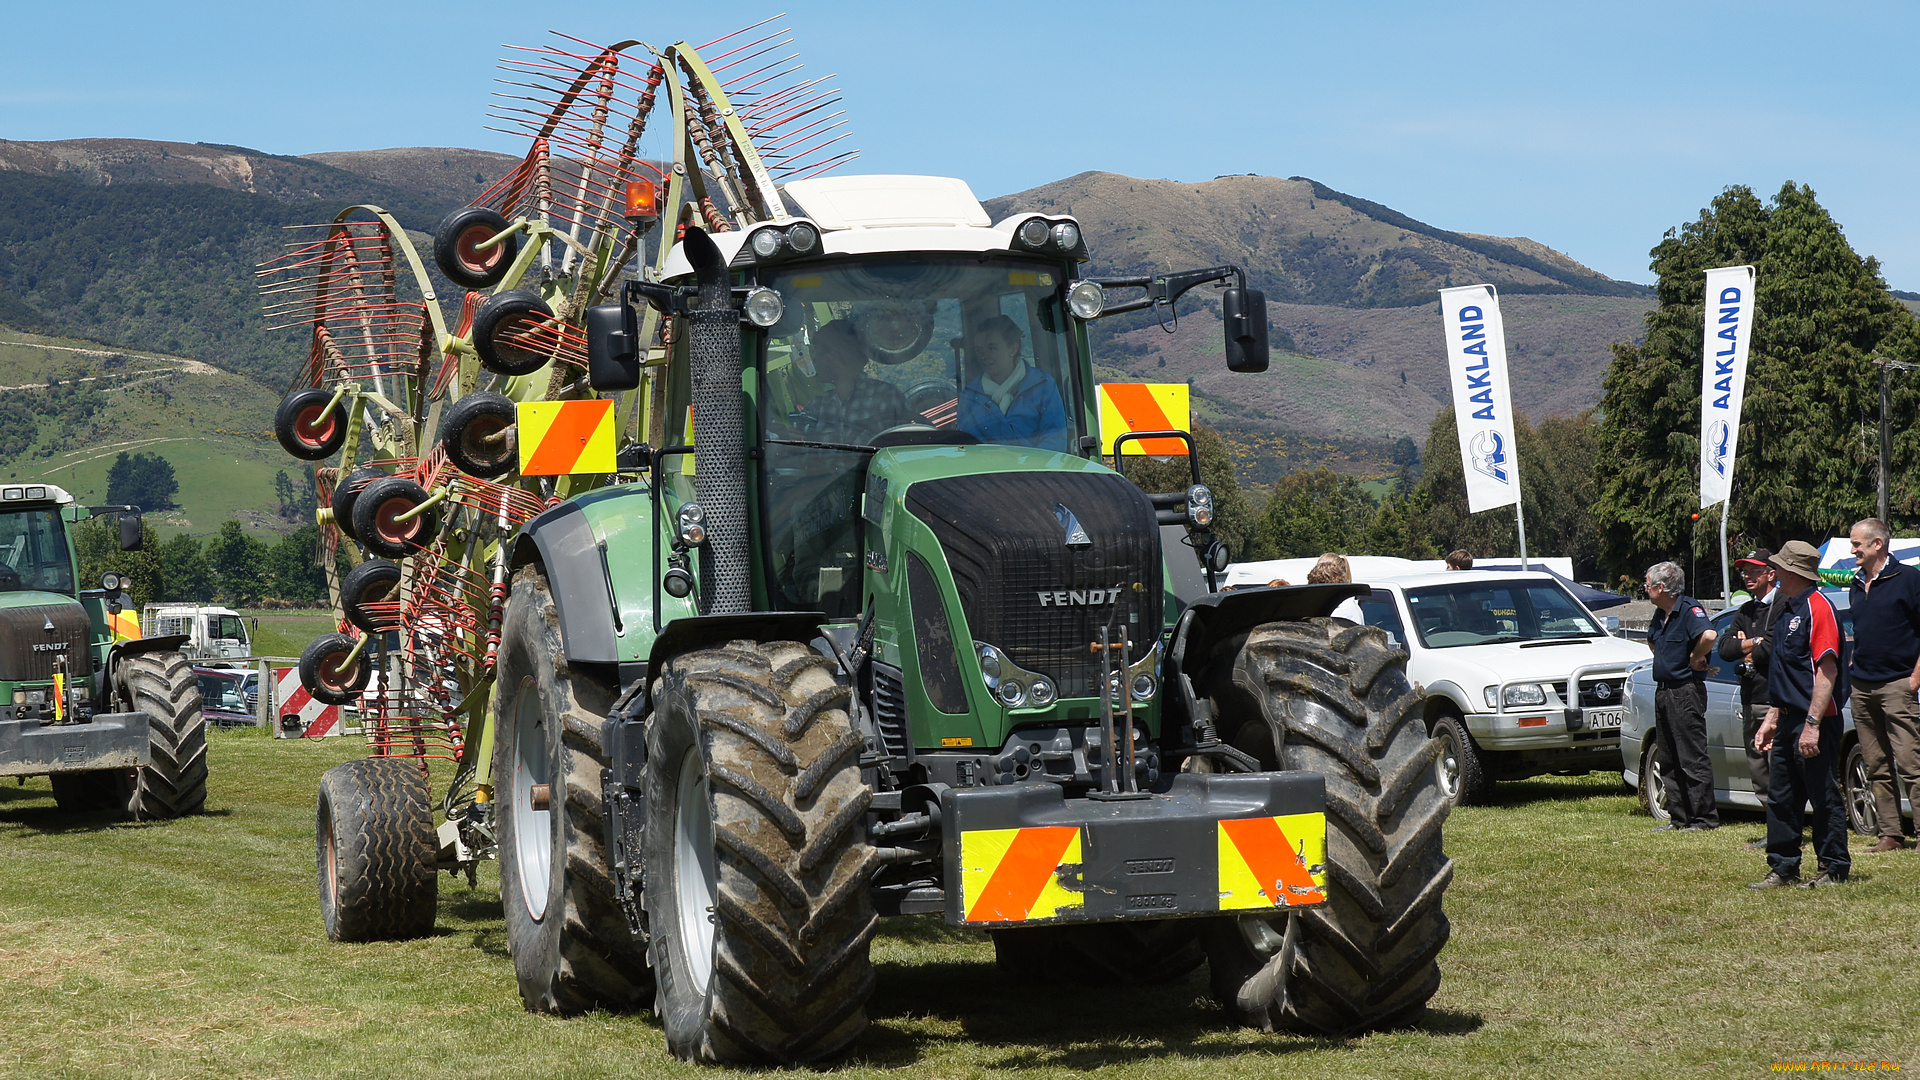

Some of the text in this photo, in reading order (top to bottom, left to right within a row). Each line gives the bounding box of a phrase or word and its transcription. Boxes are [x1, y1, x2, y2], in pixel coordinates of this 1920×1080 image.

[1713, 287, 1741, 410] AAKLAND
[1458, 305, 1495, 420] AAKLAND
[1036, 587, 1123, 607] FENDT
[32, 642, 69, 652] FENDT
[1126, 859, 1173, 874] FENDT
